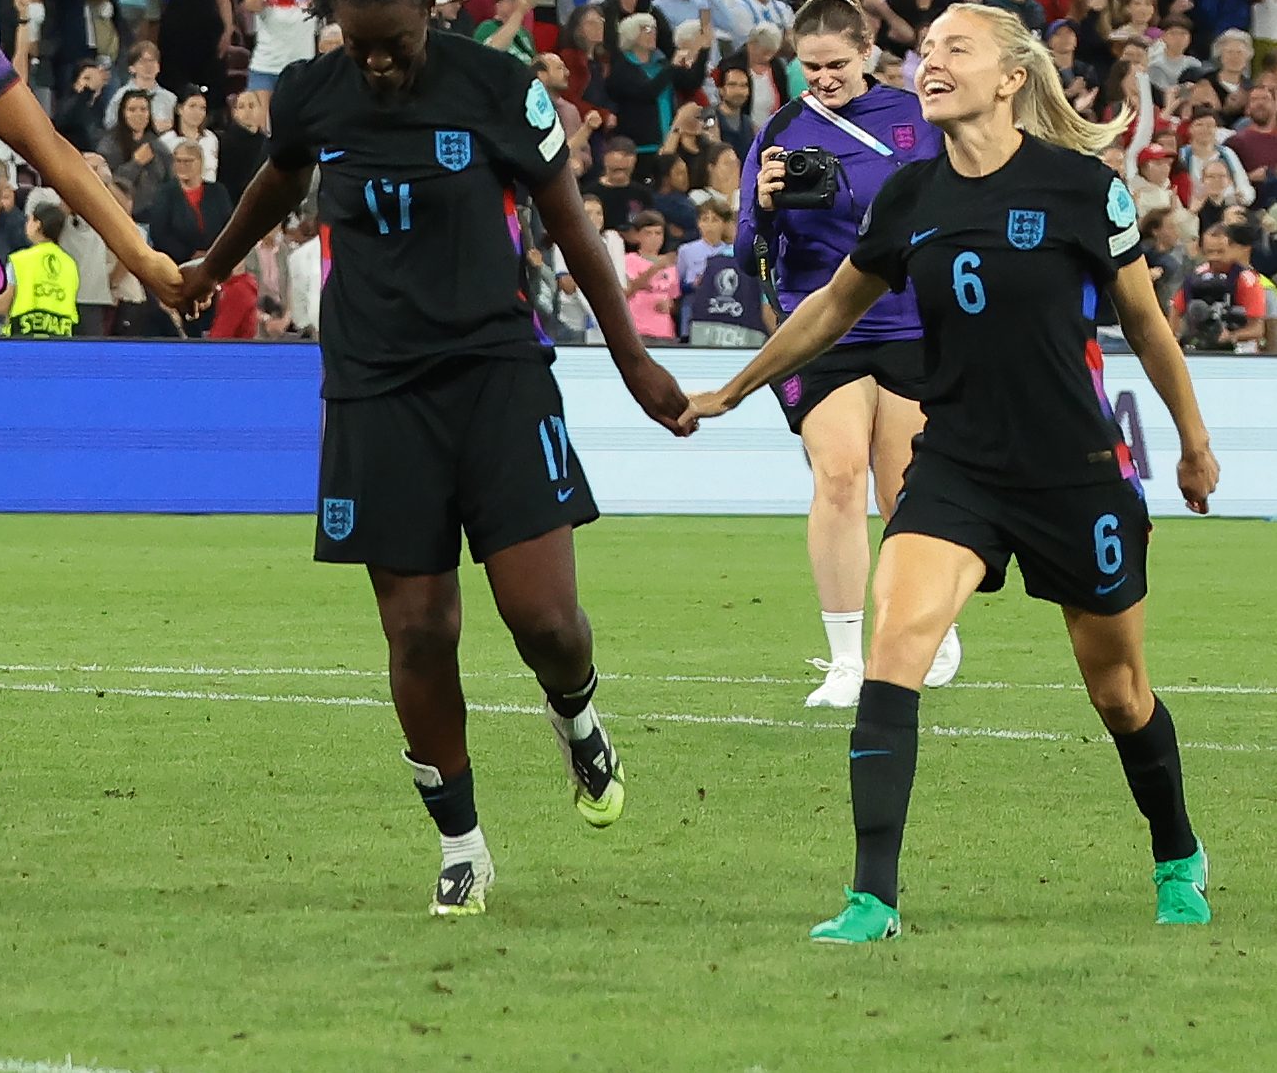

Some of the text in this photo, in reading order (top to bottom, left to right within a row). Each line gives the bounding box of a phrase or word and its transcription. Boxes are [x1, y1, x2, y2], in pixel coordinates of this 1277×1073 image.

[952, 251, 986, 315] 6
[538, 415, 568, 482] 17
[1094, 513, 1123, 575] 6
